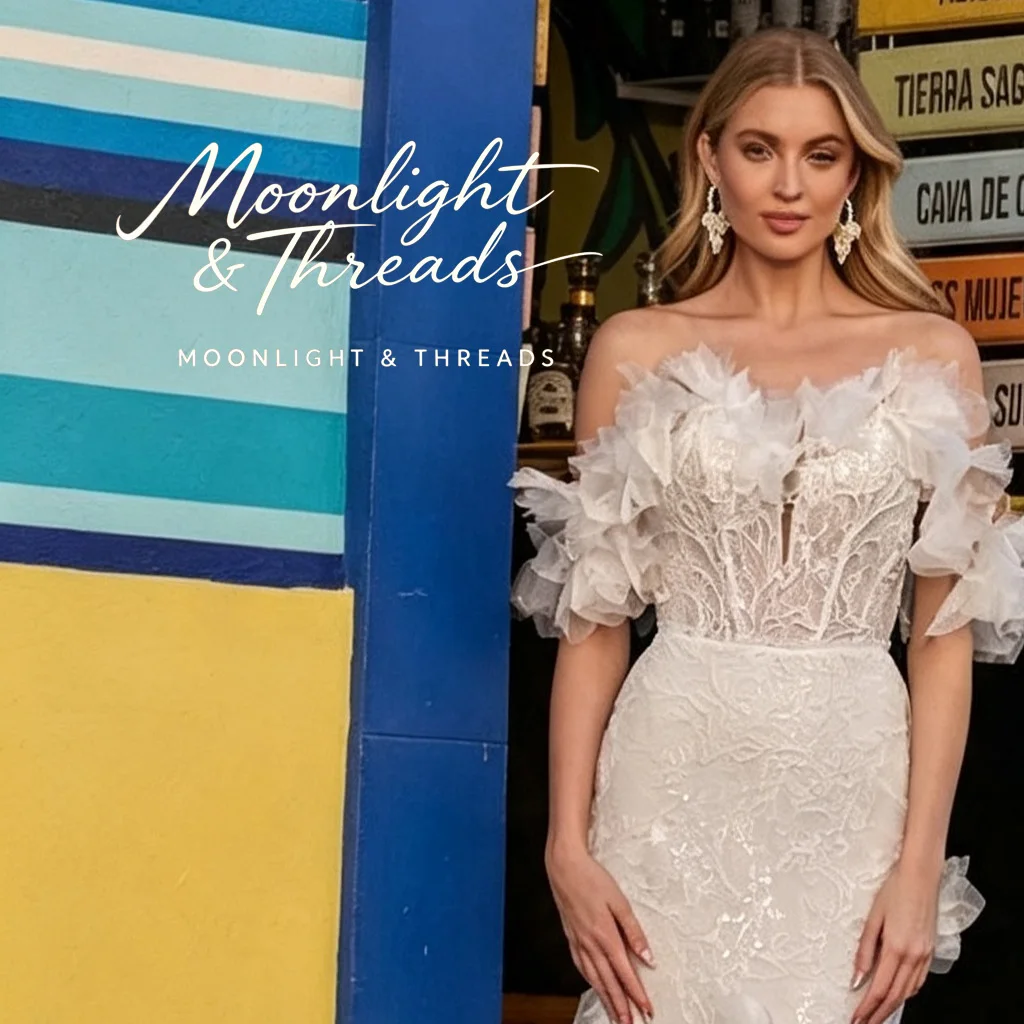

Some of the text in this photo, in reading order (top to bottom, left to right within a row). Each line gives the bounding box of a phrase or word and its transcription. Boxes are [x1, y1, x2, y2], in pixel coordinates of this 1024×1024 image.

[894, 68, 973, 118] TIERRA
[915, 178, 973, 226] CAVA
[980, 175, 1010, 221] DE
